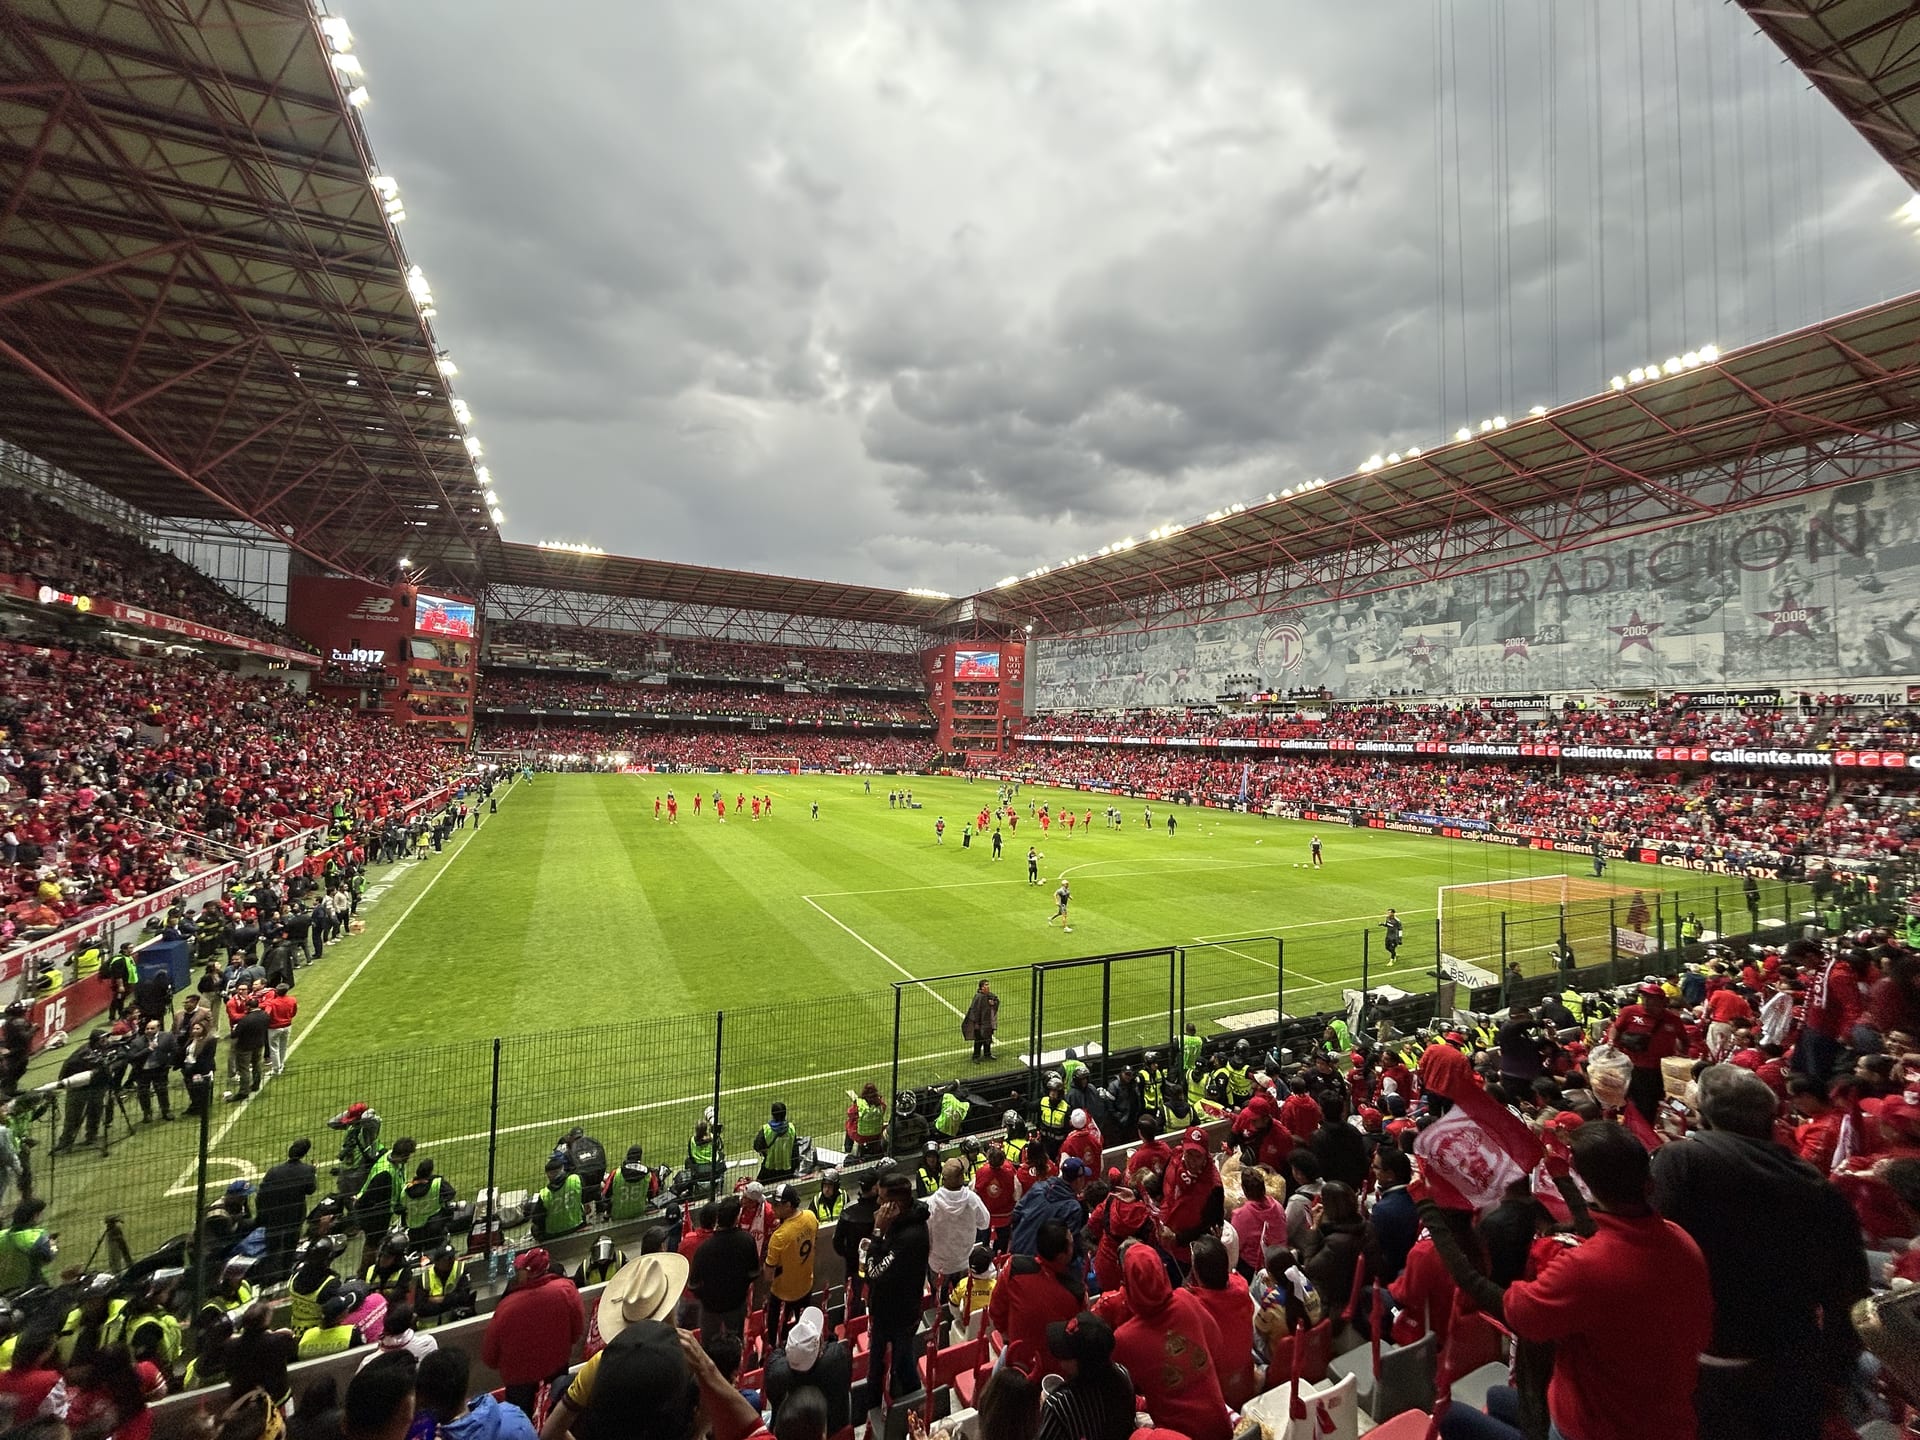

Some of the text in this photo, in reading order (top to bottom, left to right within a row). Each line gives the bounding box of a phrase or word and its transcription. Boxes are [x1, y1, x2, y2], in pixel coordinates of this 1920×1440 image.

[366, 614, 400, 622] balance
[1774, 609, 1808, 625] 2008
[1622, 625, 1648, 637] 2005
[1066, 631, 1151, 661] ORGULLO
[1505, 637, 1526, 648] 2002
[352, 648, 385, 663] 1917
[1412, 646, 1430, 656] 2000
[1490, 700, 1549, 708] caliente.mx
[1218, 738, 1258, 748] caliente.mx
[1281, 740, 1329, 750] caliente.mx
[1356, 742, 1414, 752] caliente.mx
[1449, 744, 1519, 756] caliente.mx
[1562, 746, 1654, 760] caliente.mx
[1711, 749, 1832, 765] caliente.mx
[1385, 822, 1433, 834] caliente.mx
[1517, 827, 1536, 837] Cola
[1554, 842, 1625, 859] calientmx
[1617, 937, 1648, 954] BBVA
[1450, 968, 1480, 987] BBVA
[44, 996, 67, 1038] P5
[620, 1185, 640, 1200] 35
[800, 1239, 812, 1265] 9
